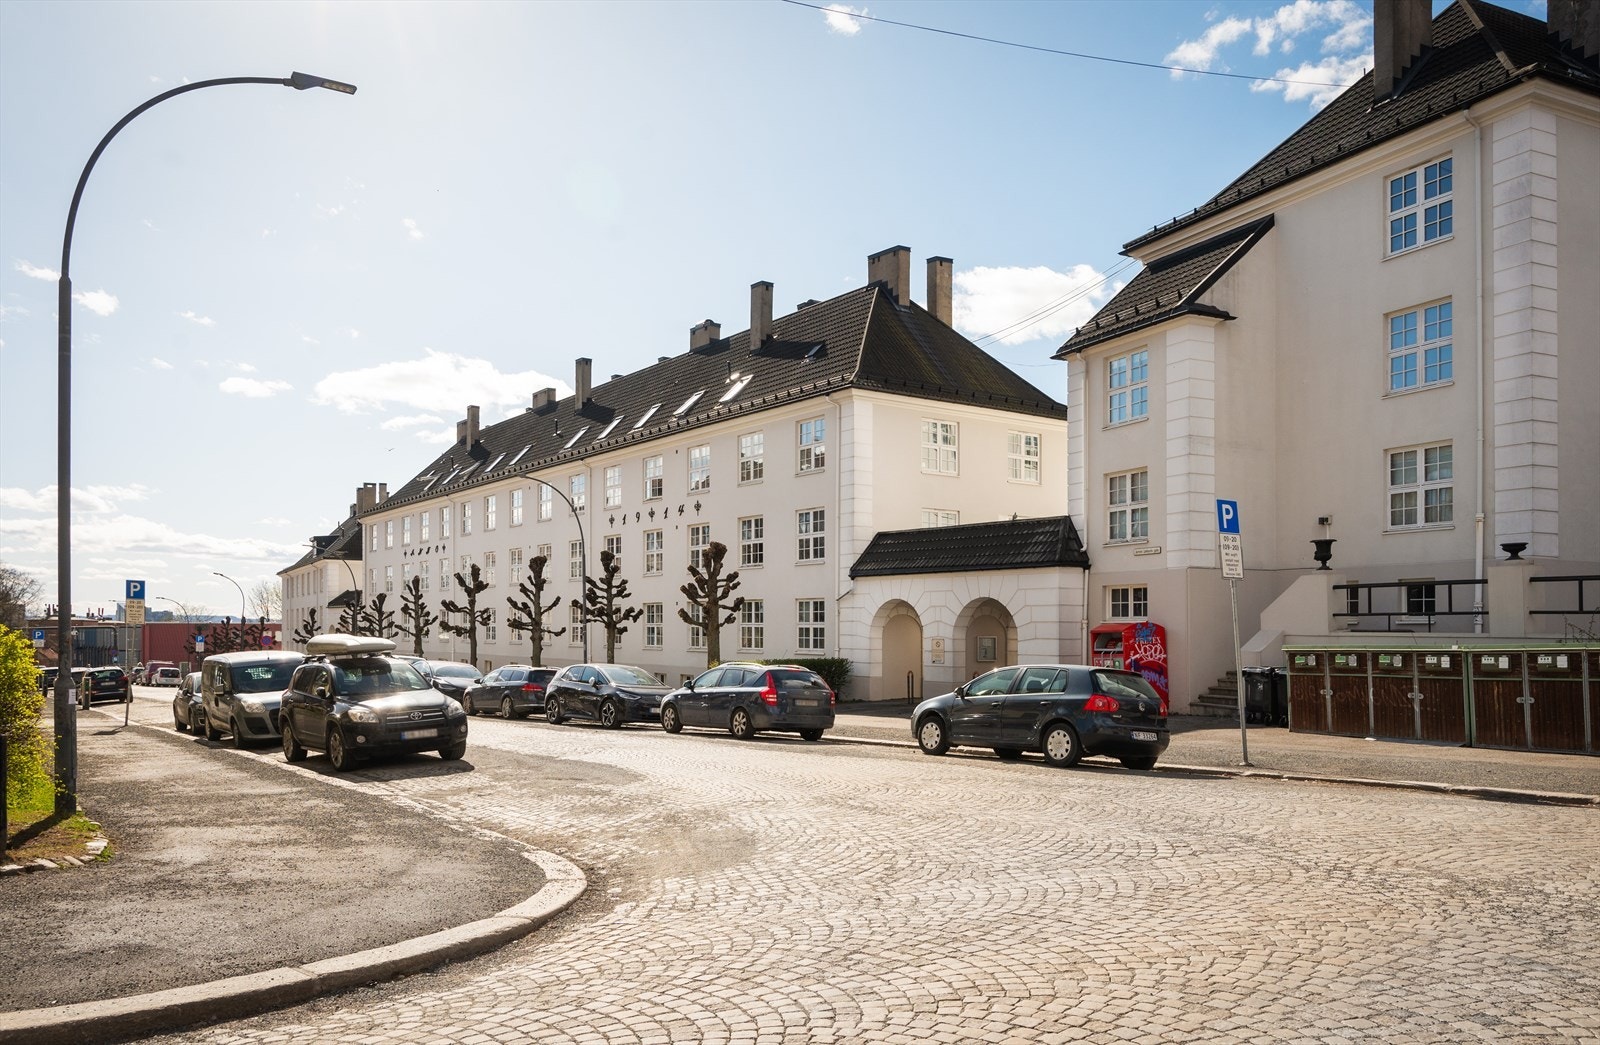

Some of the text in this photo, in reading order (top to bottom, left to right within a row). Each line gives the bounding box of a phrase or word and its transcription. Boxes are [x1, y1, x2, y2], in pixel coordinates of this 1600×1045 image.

[1222, 504, 1233, 529] P
[130, 582, 141, 597] P
[35, 631, 42, 639] P
